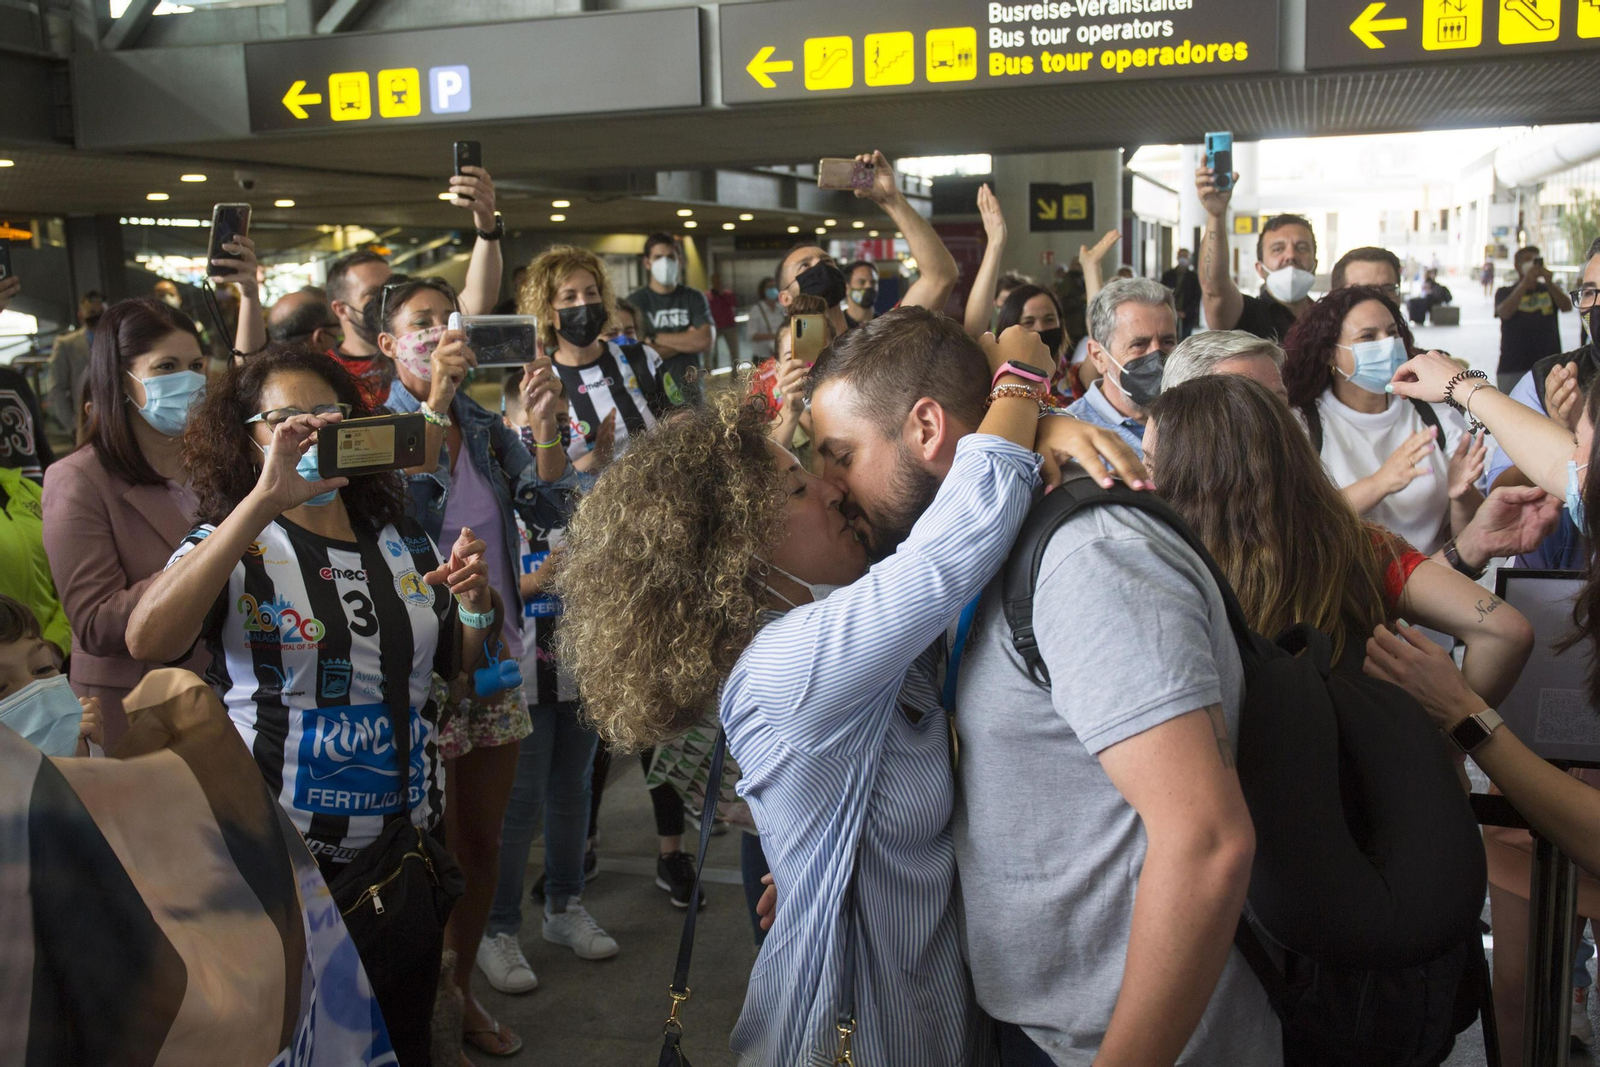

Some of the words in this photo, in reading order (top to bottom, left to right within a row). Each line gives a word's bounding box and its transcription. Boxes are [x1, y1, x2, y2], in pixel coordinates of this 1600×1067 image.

[989, 28, 1024, 48] Bus
[1030, 26, 1070, 46] tour
[1076, 18, 1174, 45] operators
[989, 52, 1034, 76] Bus
[1040, 50, 1093, 73] tour
[1100, 39, 1248, 73] operadores
[437, 70, 462, 109] P
[647, 308, 690, 328] VANS
[237, 592, 326, 643] 2020
[342, 590, 379, 637] 3
[297, 642, 306, 651] OF
[307, 786, 420, 810] FERTILIDD
